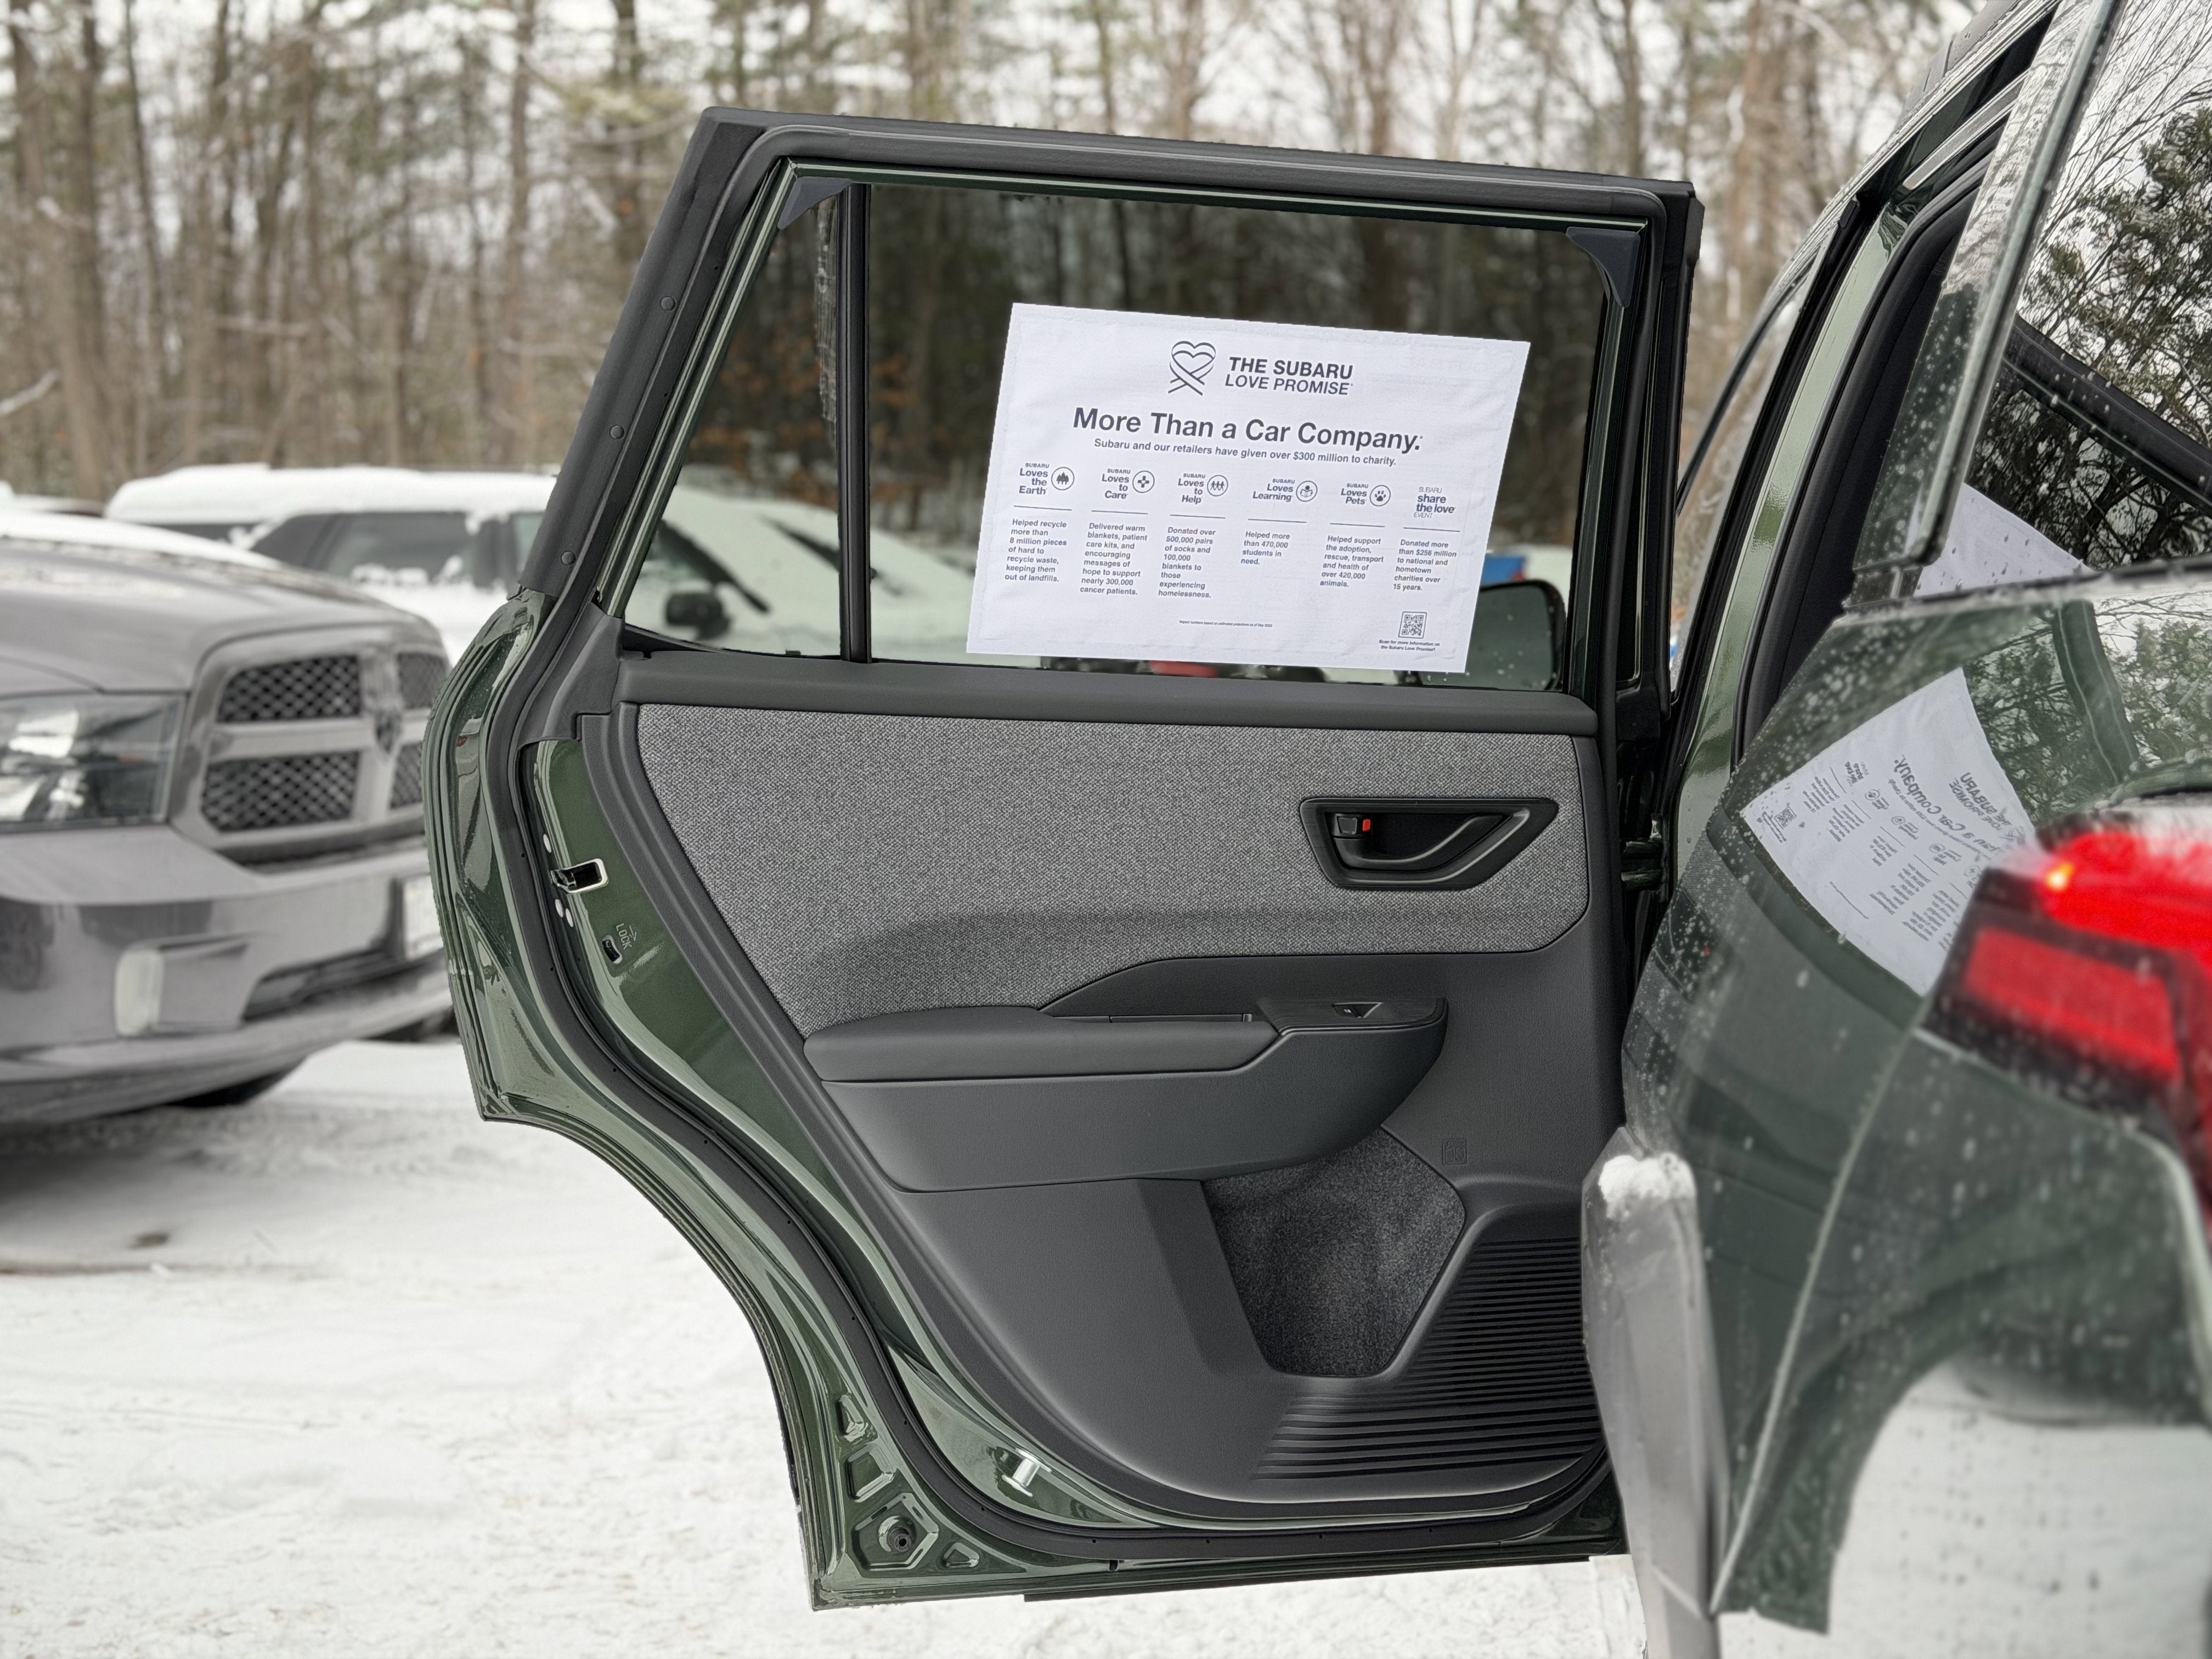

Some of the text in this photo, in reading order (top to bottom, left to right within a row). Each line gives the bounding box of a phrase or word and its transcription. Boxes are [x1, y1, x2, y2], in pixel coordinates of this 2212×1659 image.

[1229, 356, 1353, 380] THE SUBARU
[1224, 374, 1269, 390] LOVE
[1073, 407, 1141, 433] More
[1150, 412, 1214, 438] Than
[1221, 422, 1237, 439] a
[1245, 419, 1291, 442] Car
[1094, 438, 1130, 449] Subaru
[1132, 441, 1152, 450] and
[1172, 444, 1212, 454] retailers
[1215, 446, 1238, 456] have
[1240, 448, 1267, 459] given
[1293, 451, 1316, 461] $300
[1317, 453, 1348, 462] million
[1351, 454, 1361, 464] to
[1363, 455, 1396, 467] charity.
[1019, 467, 1048, 478] Loves
[1031, 477, 1047, 487] the
[1101, 473, 1130, 483] Loves
[1177, 478, 1205, 487] Loves
[1119, 483, 1128, 492] to
[1194, 487, 1203, 495] to
[1266, 483, 1294, 493] Loves
[1340, 488, 1368, 497] Loves
[1417, 493, 1447, 505] share
[1415, 503, 1433, 512] the
[1012, 518, 1066, 529] Helped recycle
[1088, 522, 1124, 531] Delivered
[1167, 526, 1198, 535] Donated
[1245, 531, 1271, 539] Helped
[1087, 531, 1148, 541] blankets, patient
[1166, 535, 1213, 545] 500,000 pairs
[1327, 535, 1353, 544] Helped
[1042, 538, 1067, 546] pieces
[1104, 541, 1119, 550] kits,
[1261, 540, 1289, 549] 470,000
[1400, 539, 1430, 547] Donated
[1018, 546, 1035, 554] hard
[1242, 549, 1273, 557] students
[1338, 545, 1372, 554] adoption,
[1085, 551, 1131, 560] encouraging
[1164, 553, 1191, 562] 100,000
[1324, 554, 1384, 563] rescue, transport
[1036, 557, 1059, 565] waste,
[1084, 560, 1121, 568] messages
[1006, 563, 1036, 574] keeping
[1161, 562, 1192, 571] blankets
[1338, 562, 1360, 570] health
[1395, 565, 1432, 574] hometown
[1082, 567, 1101, 577] hope
[1339, 571, 1365, 579] 420,000
[1028, 574, 1059, 582] landfills.
[1081, 577, 1133, 586] nearly 300,000
[1159, 581, 1205, 590] experiencing
[1106, 587, 1138, 595] patients.
[1158, 589, 1211, 598] homelessness.
[616, 923, 632, 950] LOCK
